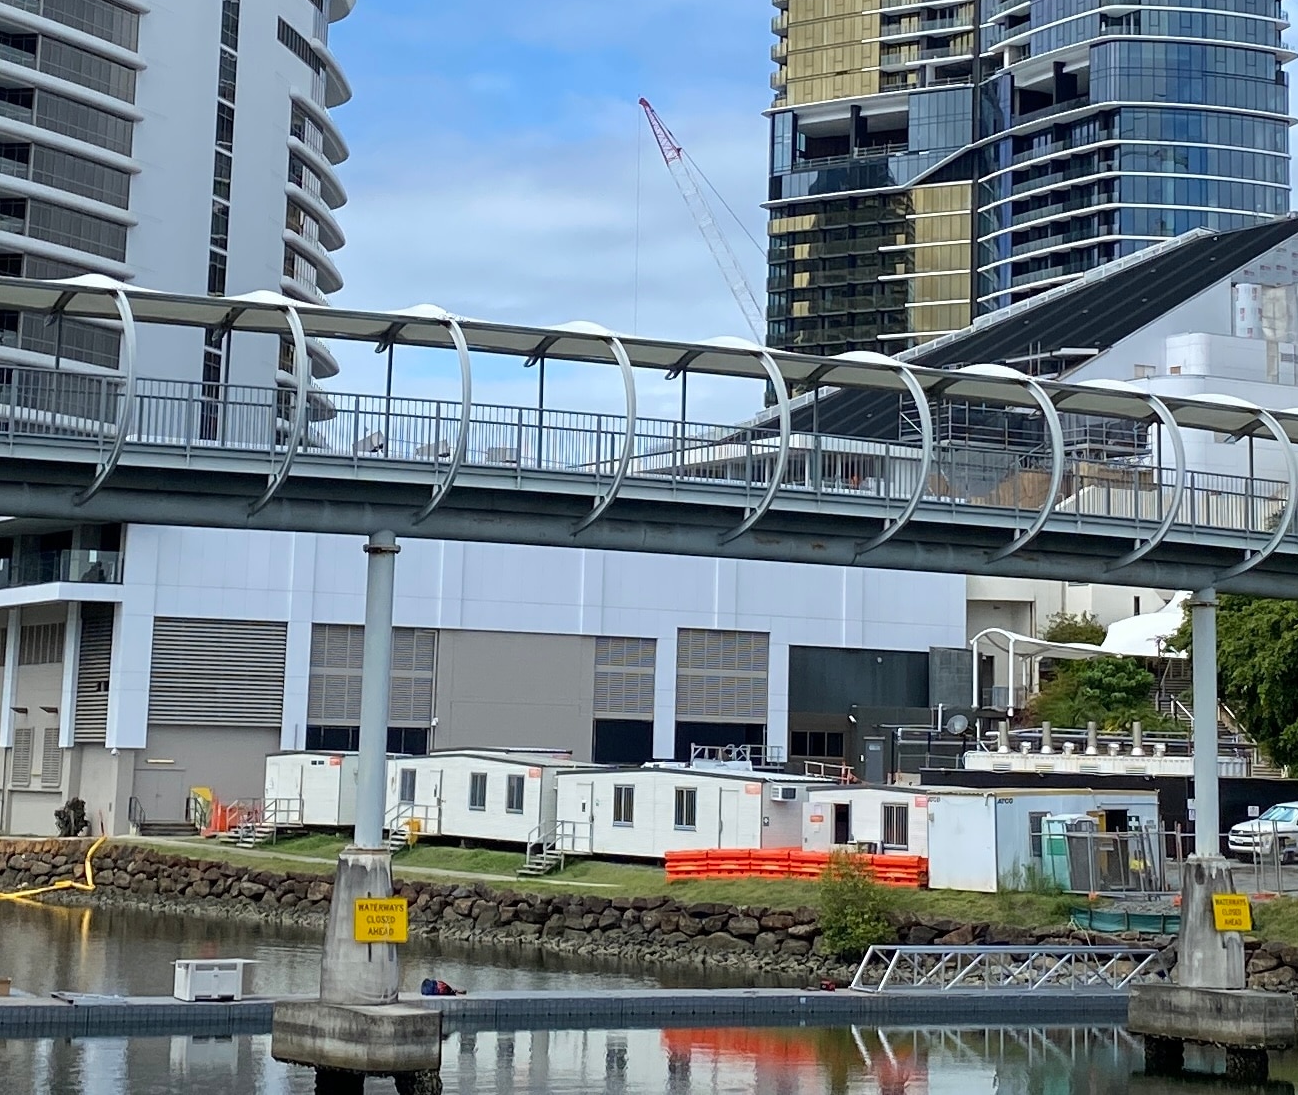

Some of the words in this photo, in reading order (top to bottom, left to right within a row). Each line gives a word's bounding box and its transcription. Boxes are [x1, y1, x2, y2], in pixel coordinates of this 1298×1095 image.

[997, 797, 1014, 805] ATCO
[1215, 899, 1247, 907] WATERWAYS
[358, 903, 404, 913] WATERWAYS
[1221, 908, 1242, 916] CLOSED
[366, 916, 396, 924] CLOSED
[1224, 918, 1243, 926] AHEAD
[367, 927, 395, 936] AHEAD
